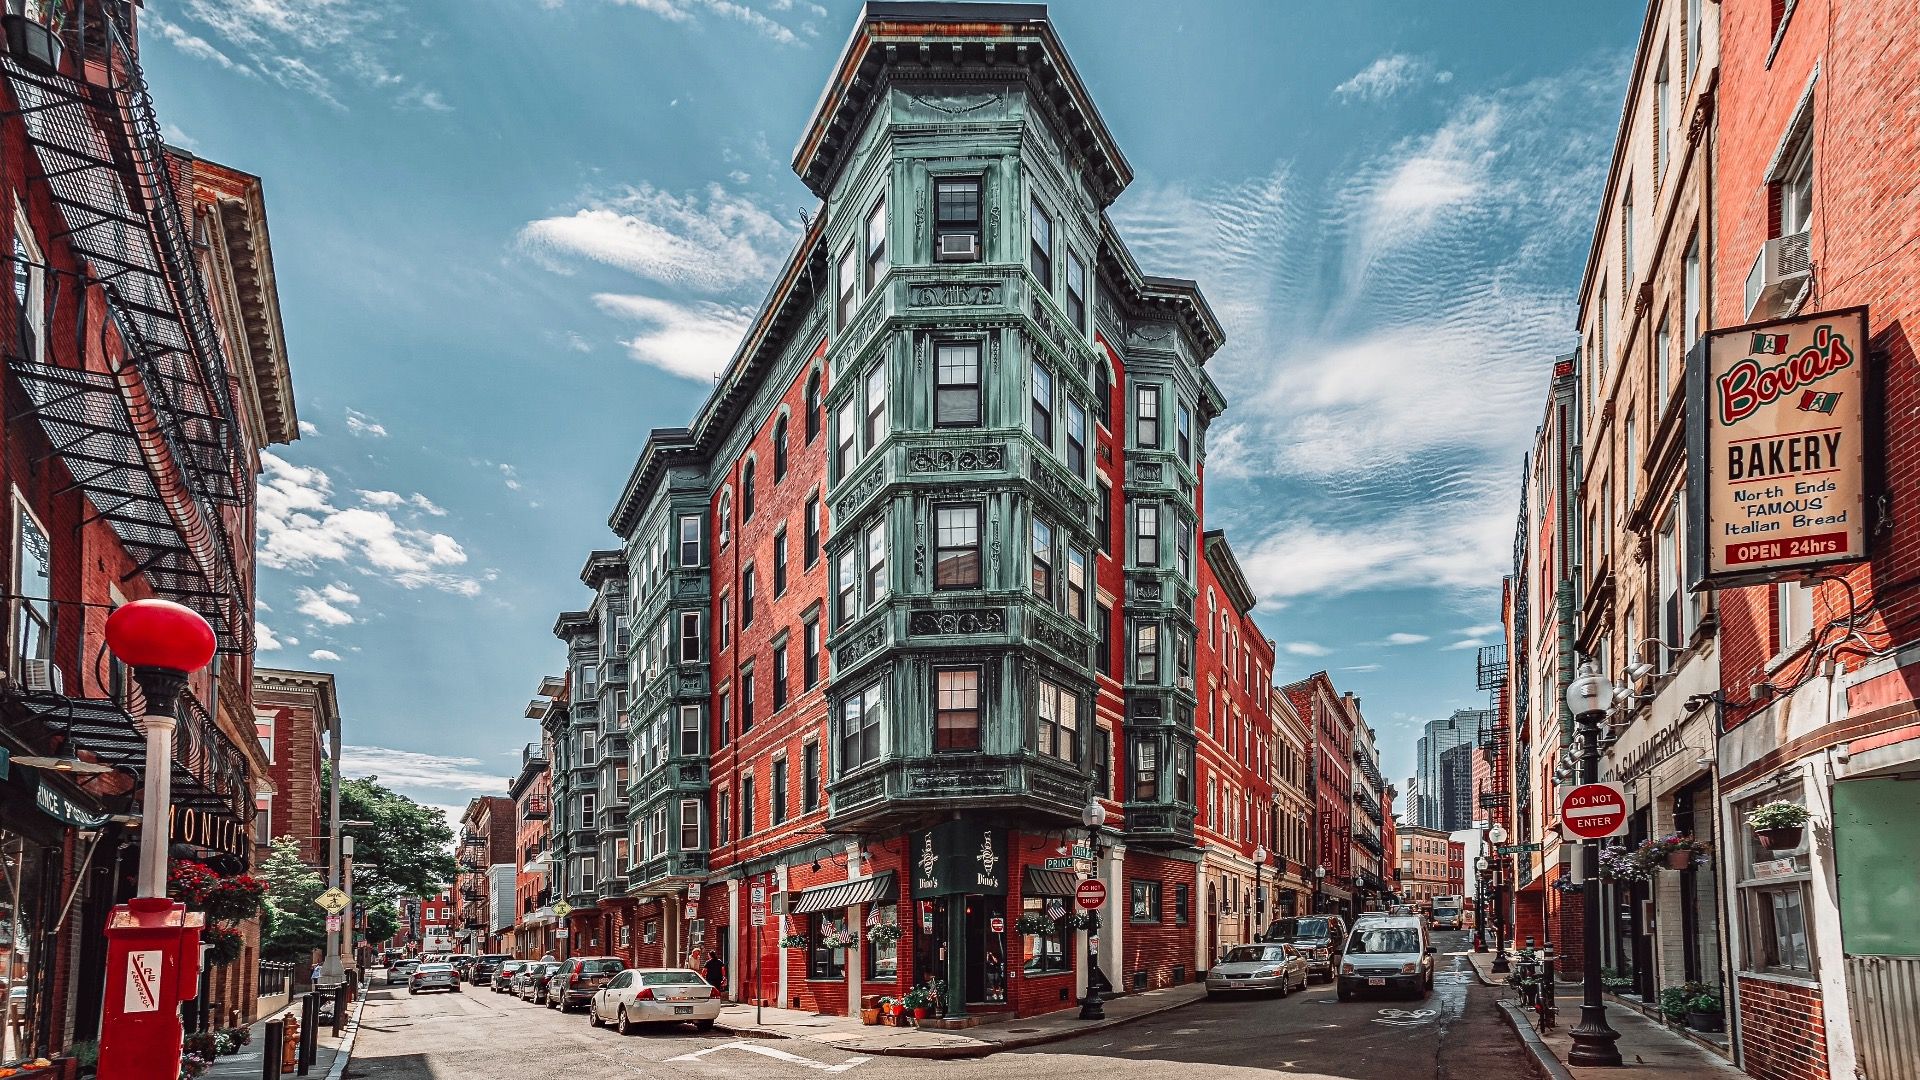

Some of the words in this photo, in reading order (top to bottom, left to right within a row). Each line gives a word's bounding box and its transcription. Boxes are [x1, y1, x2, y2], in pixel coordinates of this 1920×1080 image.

[1717, 325, 1854, 426] Bova's
[1728, 432, 1842, 480] BAKERY
[1734, 486, 1783, 502] North
[1795, 478, 1836, 494] End's
[1725, 521, 1780, 535] Italian
[1793, 510, 1847, 527] Bread
[1738, 543, 1780, 560] OPEN
[1790, 539, 1837, 555] 24hrs
[1622, 719, 1683, 780] SALUMERIA
[1572, 797, 1586, 805] DO
[1592, 794, 1612, 804] NOT
[1577, 817, 1612, 828] ENTER
[1047, 857, 1074, 869] PRINC
[919, 877, 938, 889] Dino's
[977, 872, 999, 888] Dino's
[136, 953, 156, 982] FIRE
